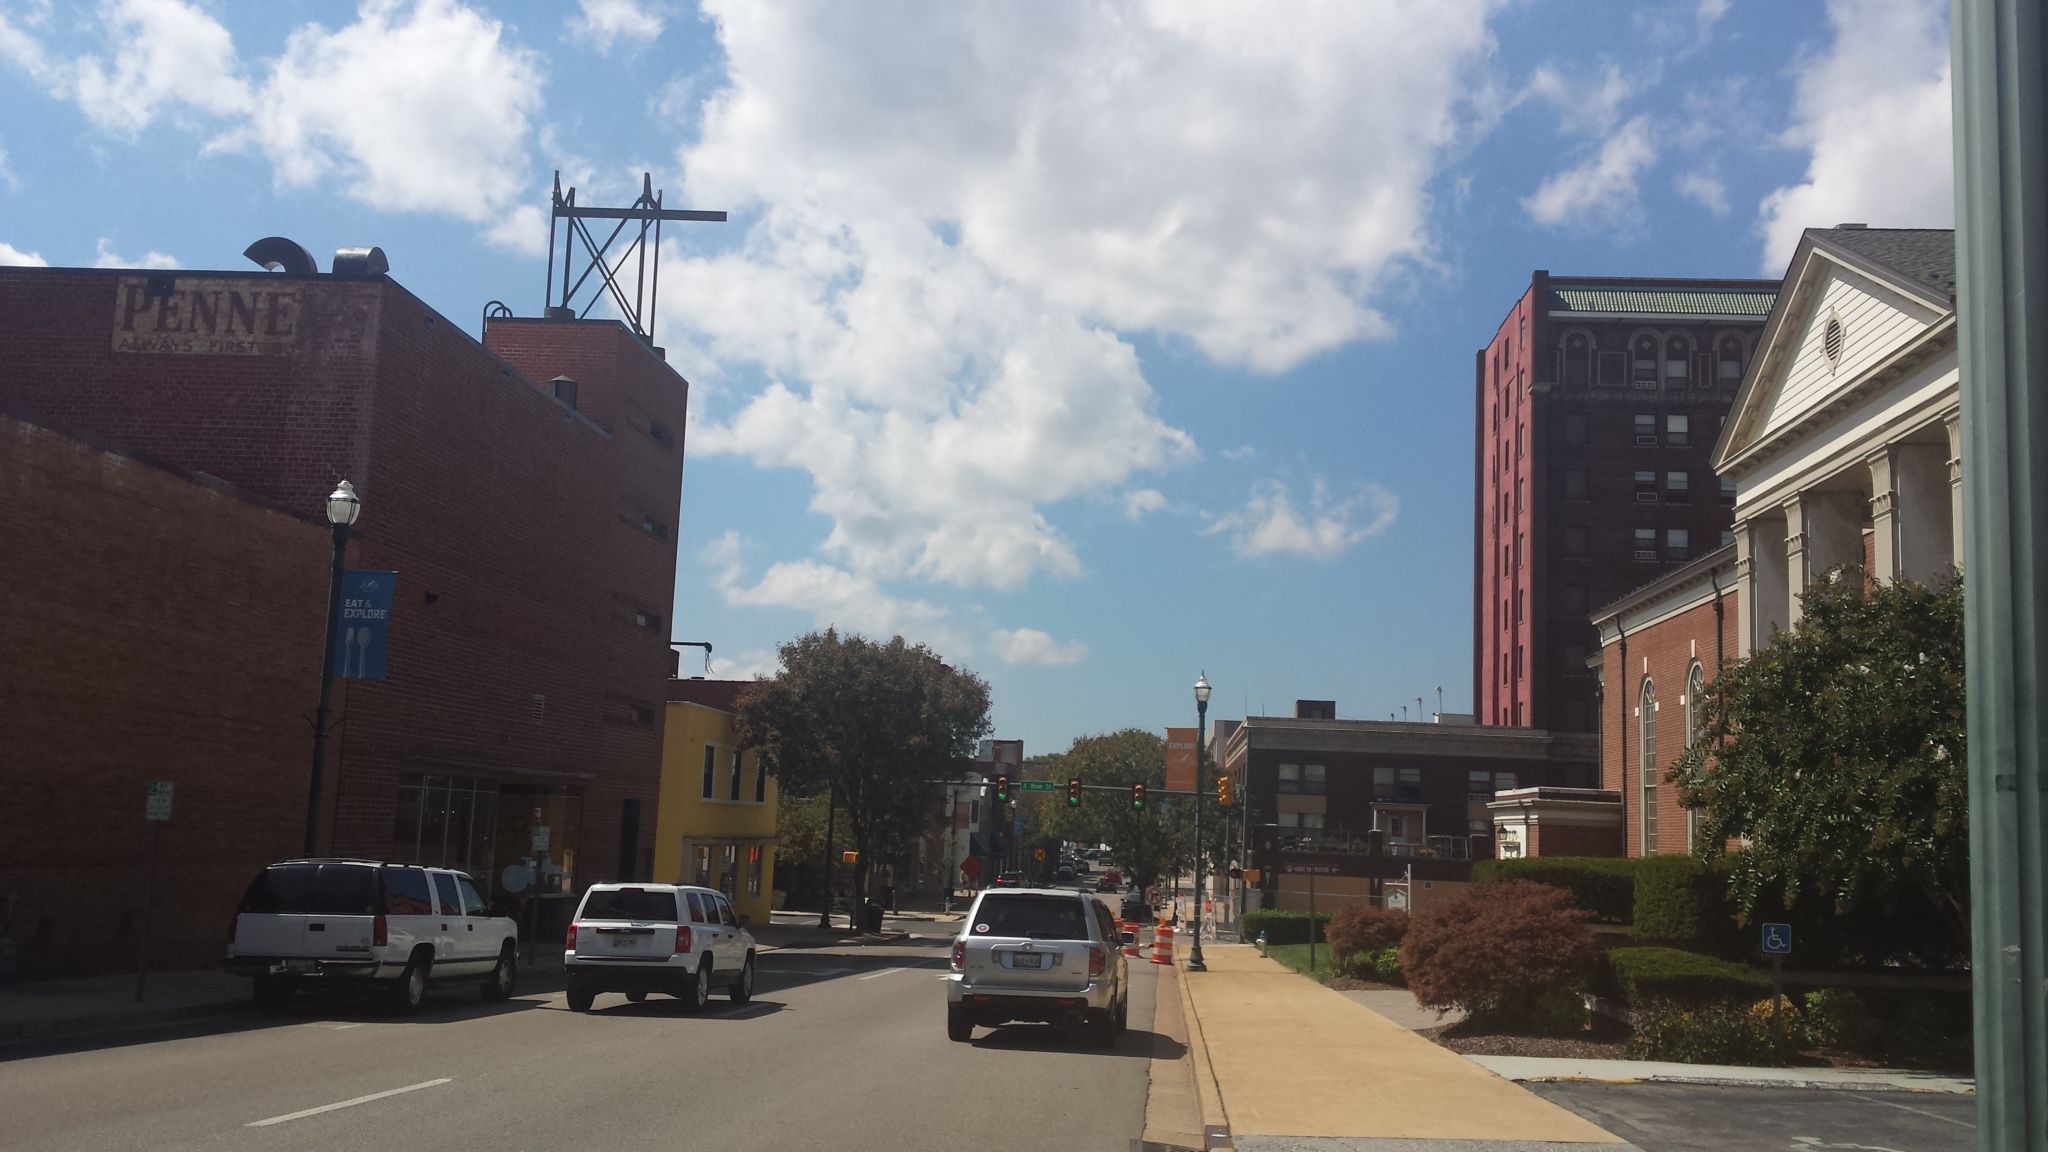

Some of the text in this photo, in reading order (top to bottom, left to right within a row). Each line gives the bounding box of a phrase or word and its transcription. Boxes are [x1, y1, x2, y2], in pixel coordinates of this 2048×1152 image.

[119, 339, 257, 353] ALWAYS FIRST
[345, 599, 372, 608] EAT &
[344, 608, 386, 619] EXPLORE
